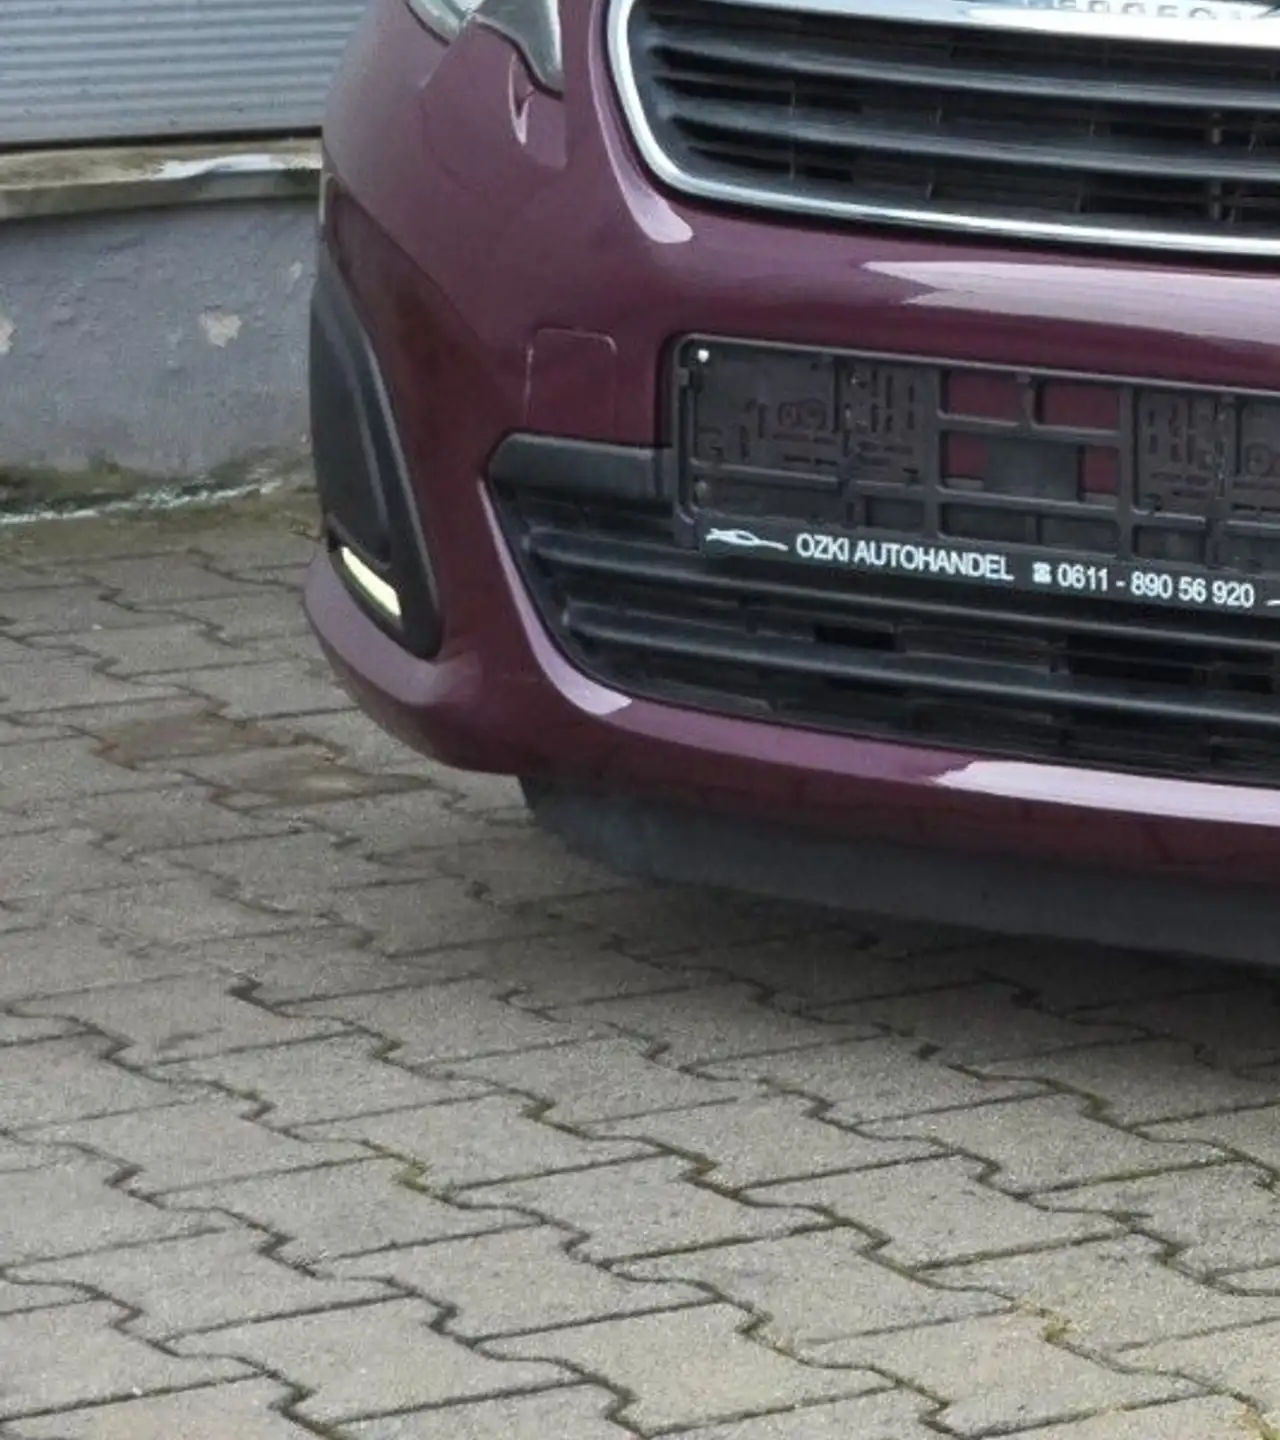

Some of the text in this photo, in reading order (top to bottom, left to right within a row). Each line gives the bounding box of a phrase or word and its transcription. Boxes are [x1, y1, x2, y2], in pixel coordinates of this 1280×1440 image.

[796, 532, 850, 561] OZKI
[854, 540, 1015, 581] AUTOHANDEL
[1057, 563, 1109, 591] 0611
[1130, 571, 1173, 599] 890
[1178, 576, 1207, 603] 56
[1212, 581, 1256, 608] 920
